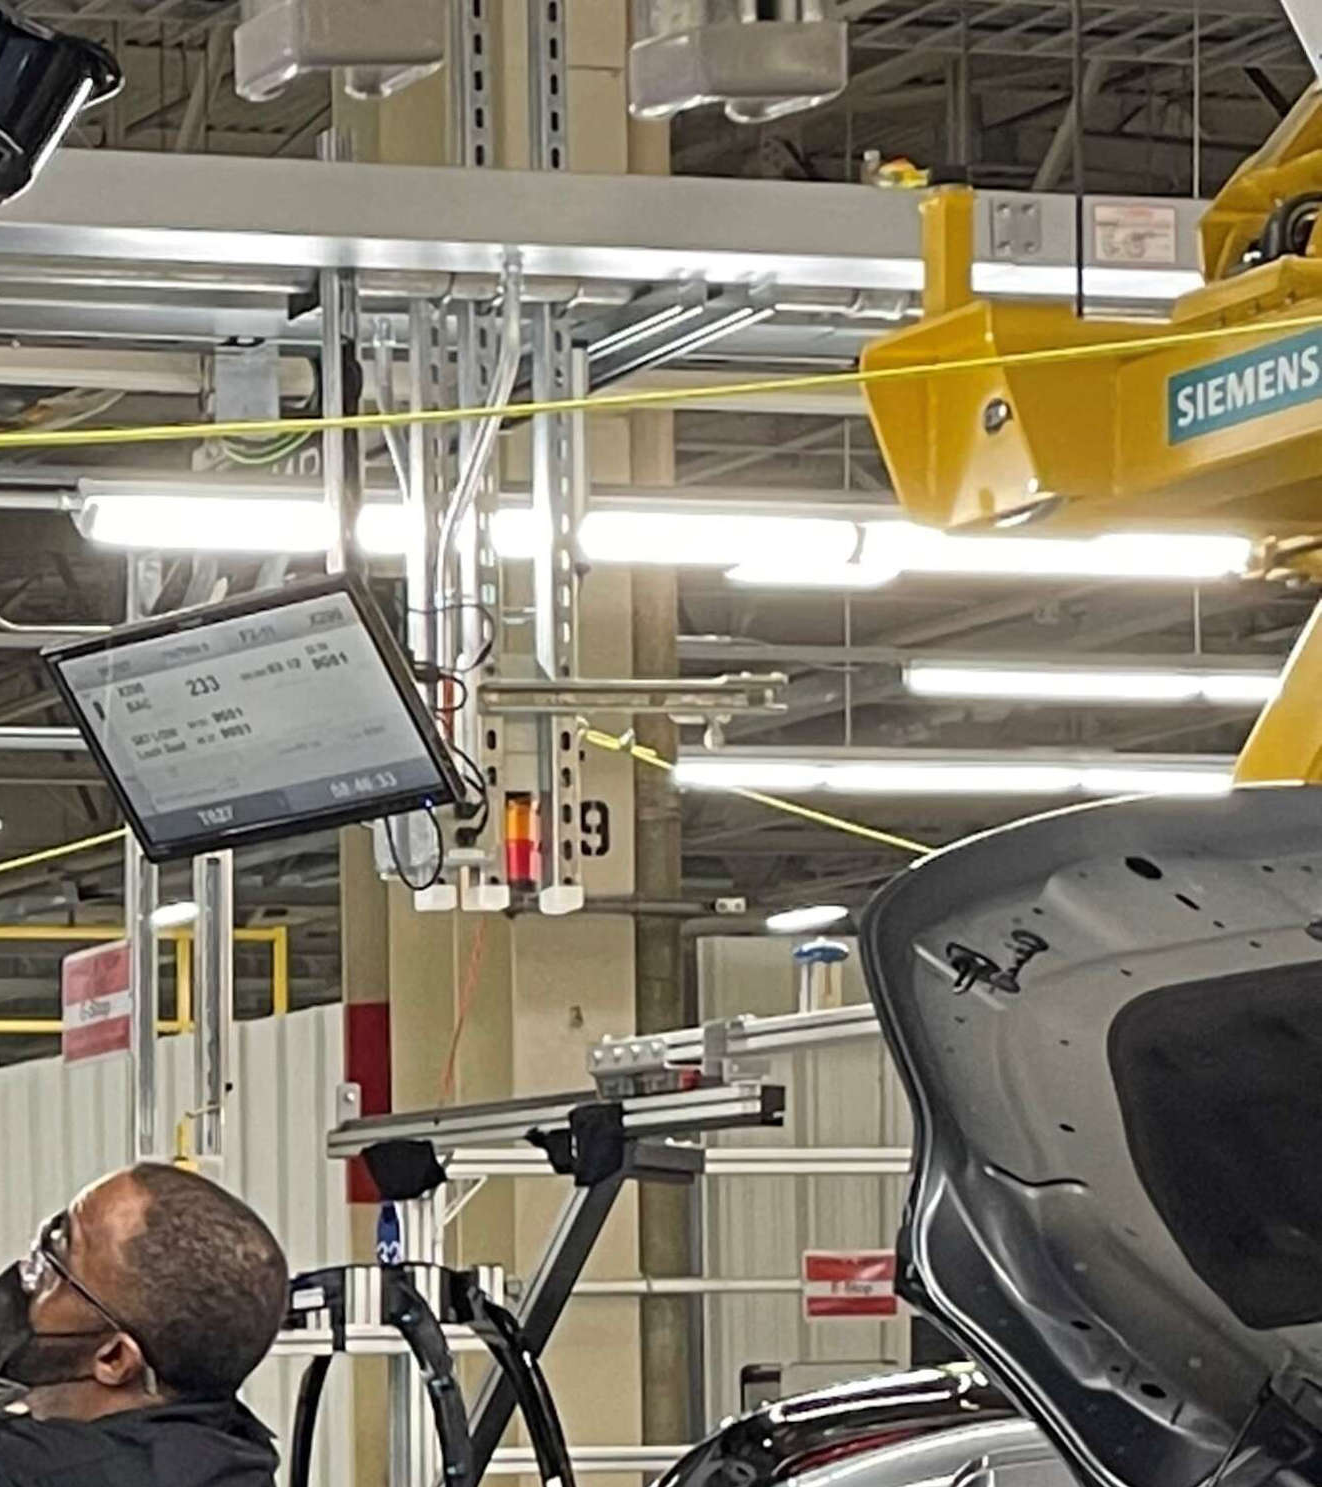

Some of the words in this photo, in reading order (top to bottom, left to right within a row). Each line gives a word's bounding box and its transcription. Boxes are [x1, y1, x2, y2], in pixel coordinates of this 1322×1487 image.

[1177, 345, 1320, 427] SIEMENS
[185, 674, 221, 698] 233
[580, 799, 611, 857] 9
